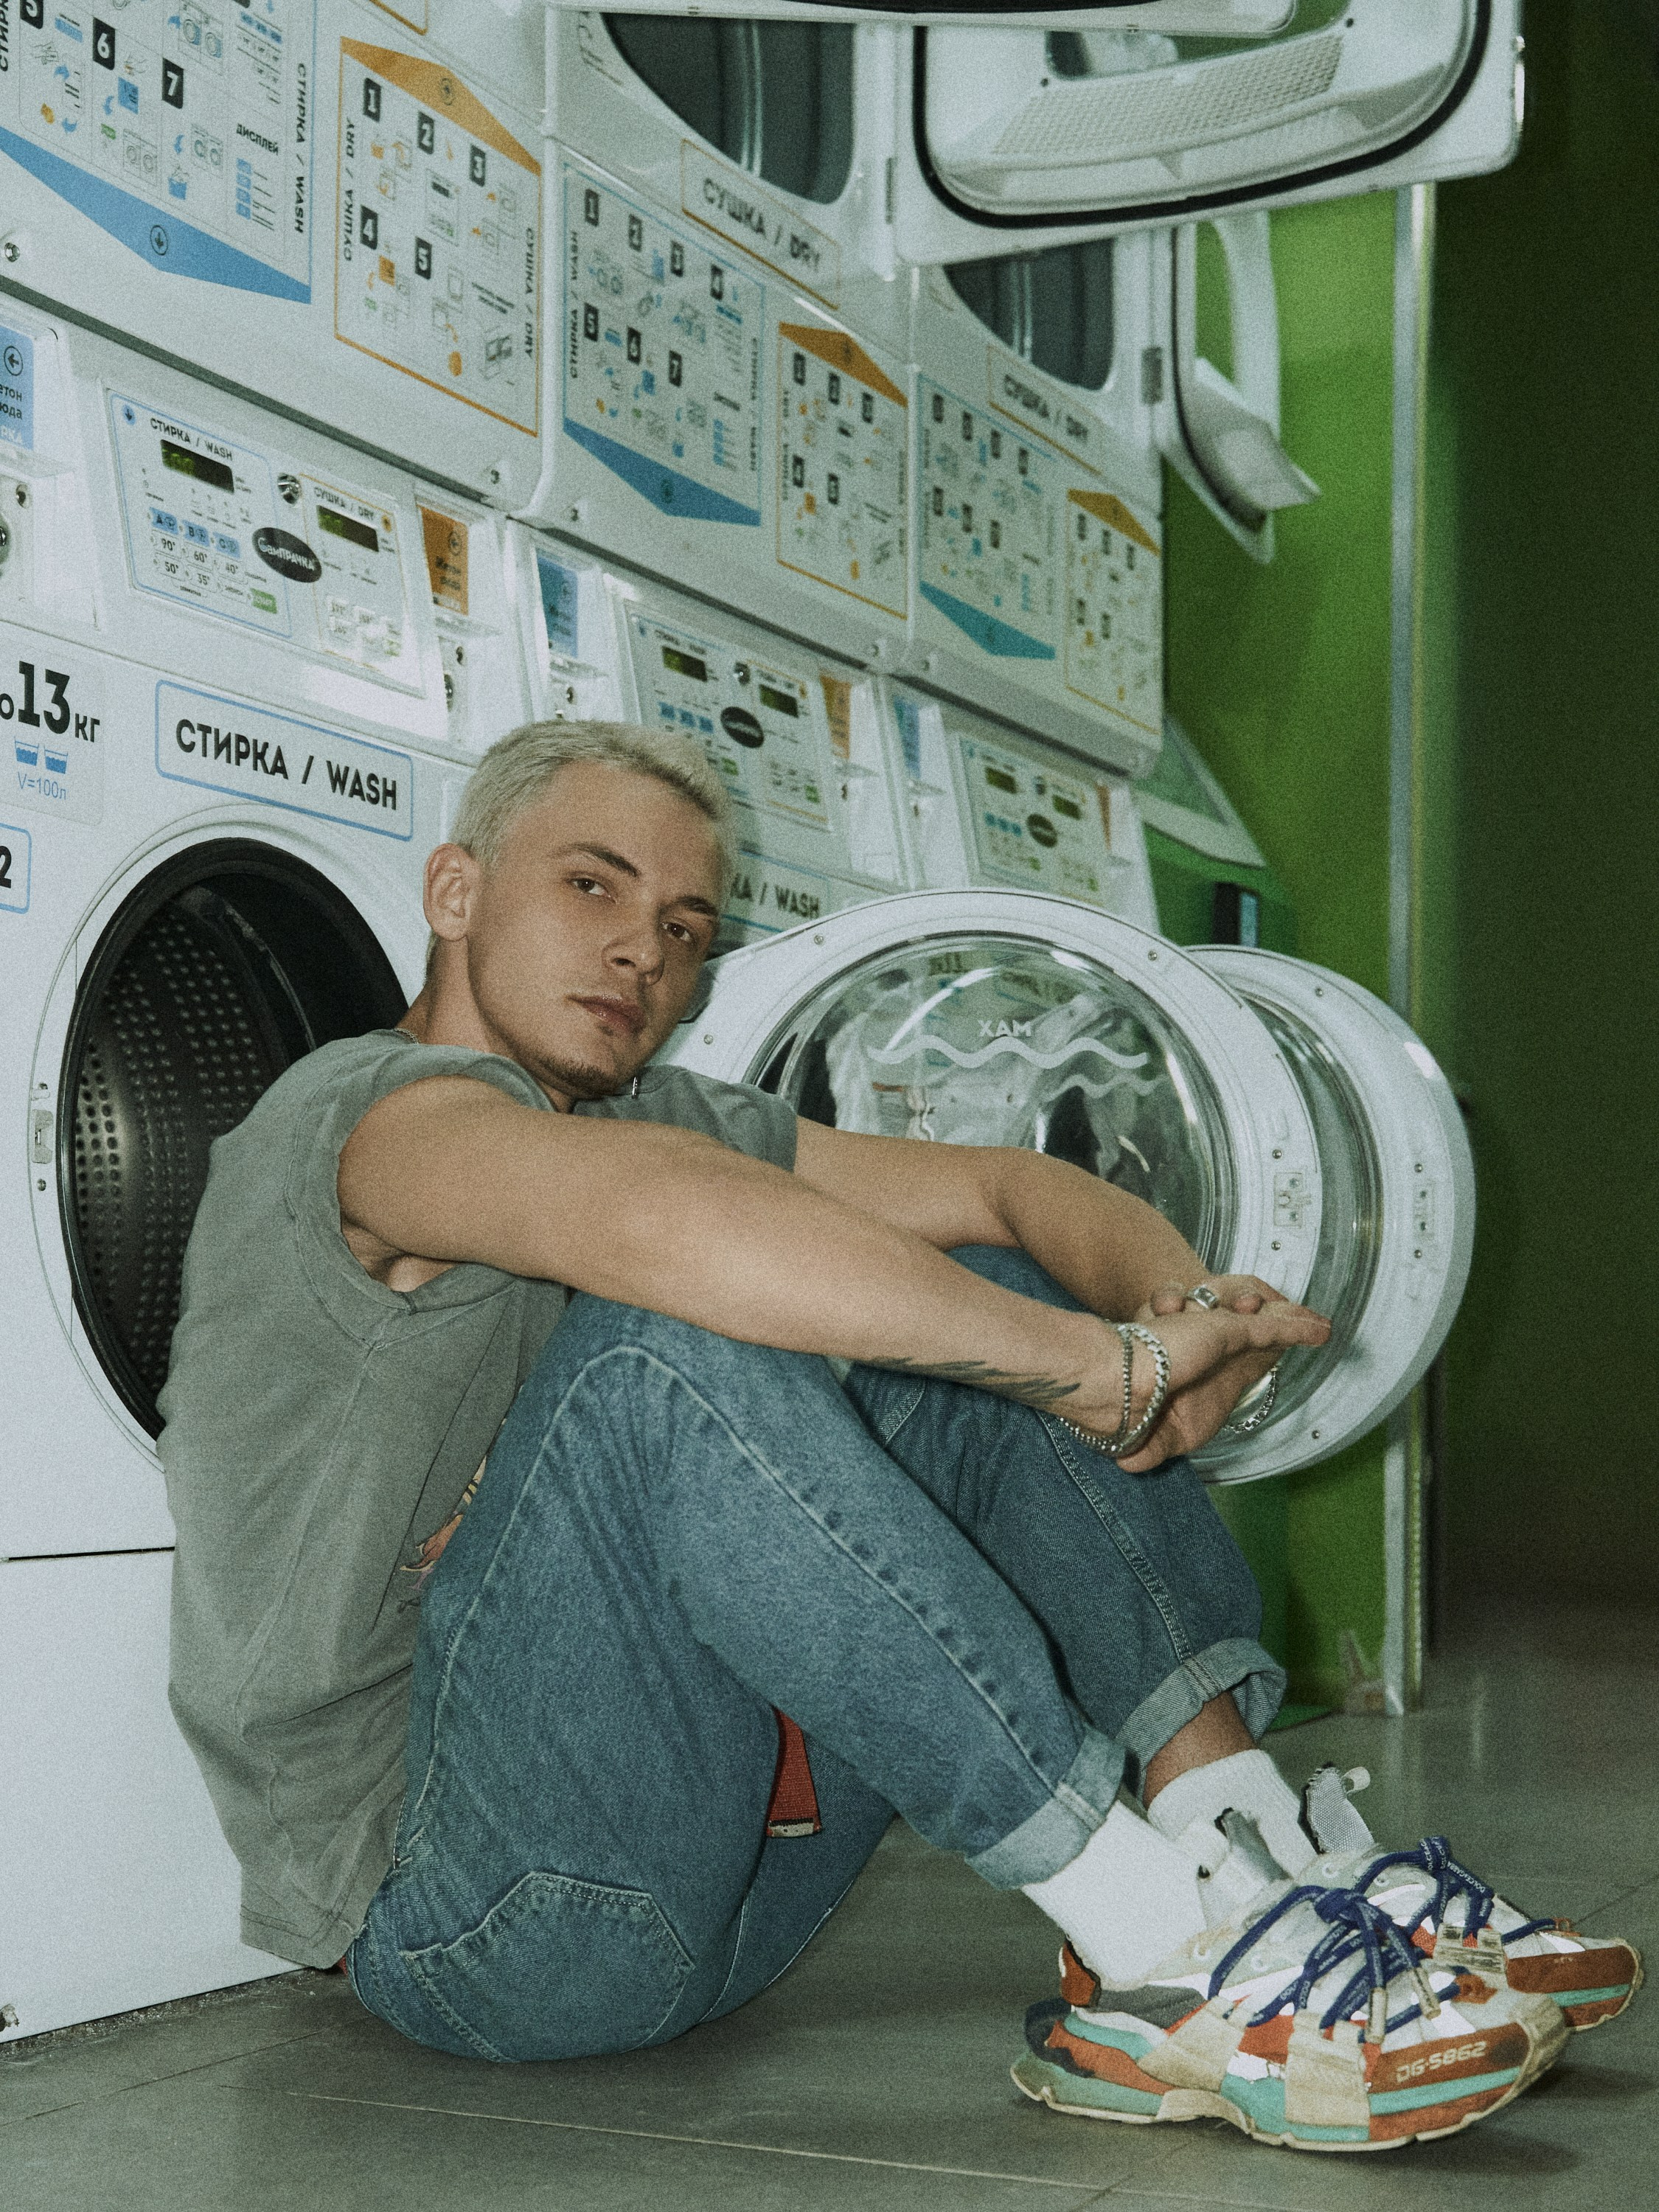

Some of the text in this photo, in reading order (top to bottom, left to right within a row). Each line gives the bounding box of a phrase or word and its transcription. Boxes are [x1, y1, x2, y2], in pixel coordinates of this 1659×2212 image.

[97, 32, 109, 59] 6
[167, 70, 179, 97] 7
[296, 63, 306, 143] СТИРКА
[237, 123, 279, 156] ДИСПЛЕЙ
[346, 118, 355, 160] DRY
[295, 176, 305, 234] WASH
[344, 187, 354, 262] СУШКА
[703, 178, 767, 240] СУШКА
[525, 227, 534, 296] СУШКА
[524, 323, 534, 358] DRY
[150, 417, 191, 445] СТИРКА
[204, 440, 234, 461] WASH
[313, 485, 347, 509] СУШКА
[358, 506, 375, 521] DRY
[176, 718, 397, 810] СТИРКА / WASH
[18, 771, 67, 801] V=100л
[774, 884, 820, 920] WASH
[1447, 1860, 1486, 1893] DOLCE&GABBA
